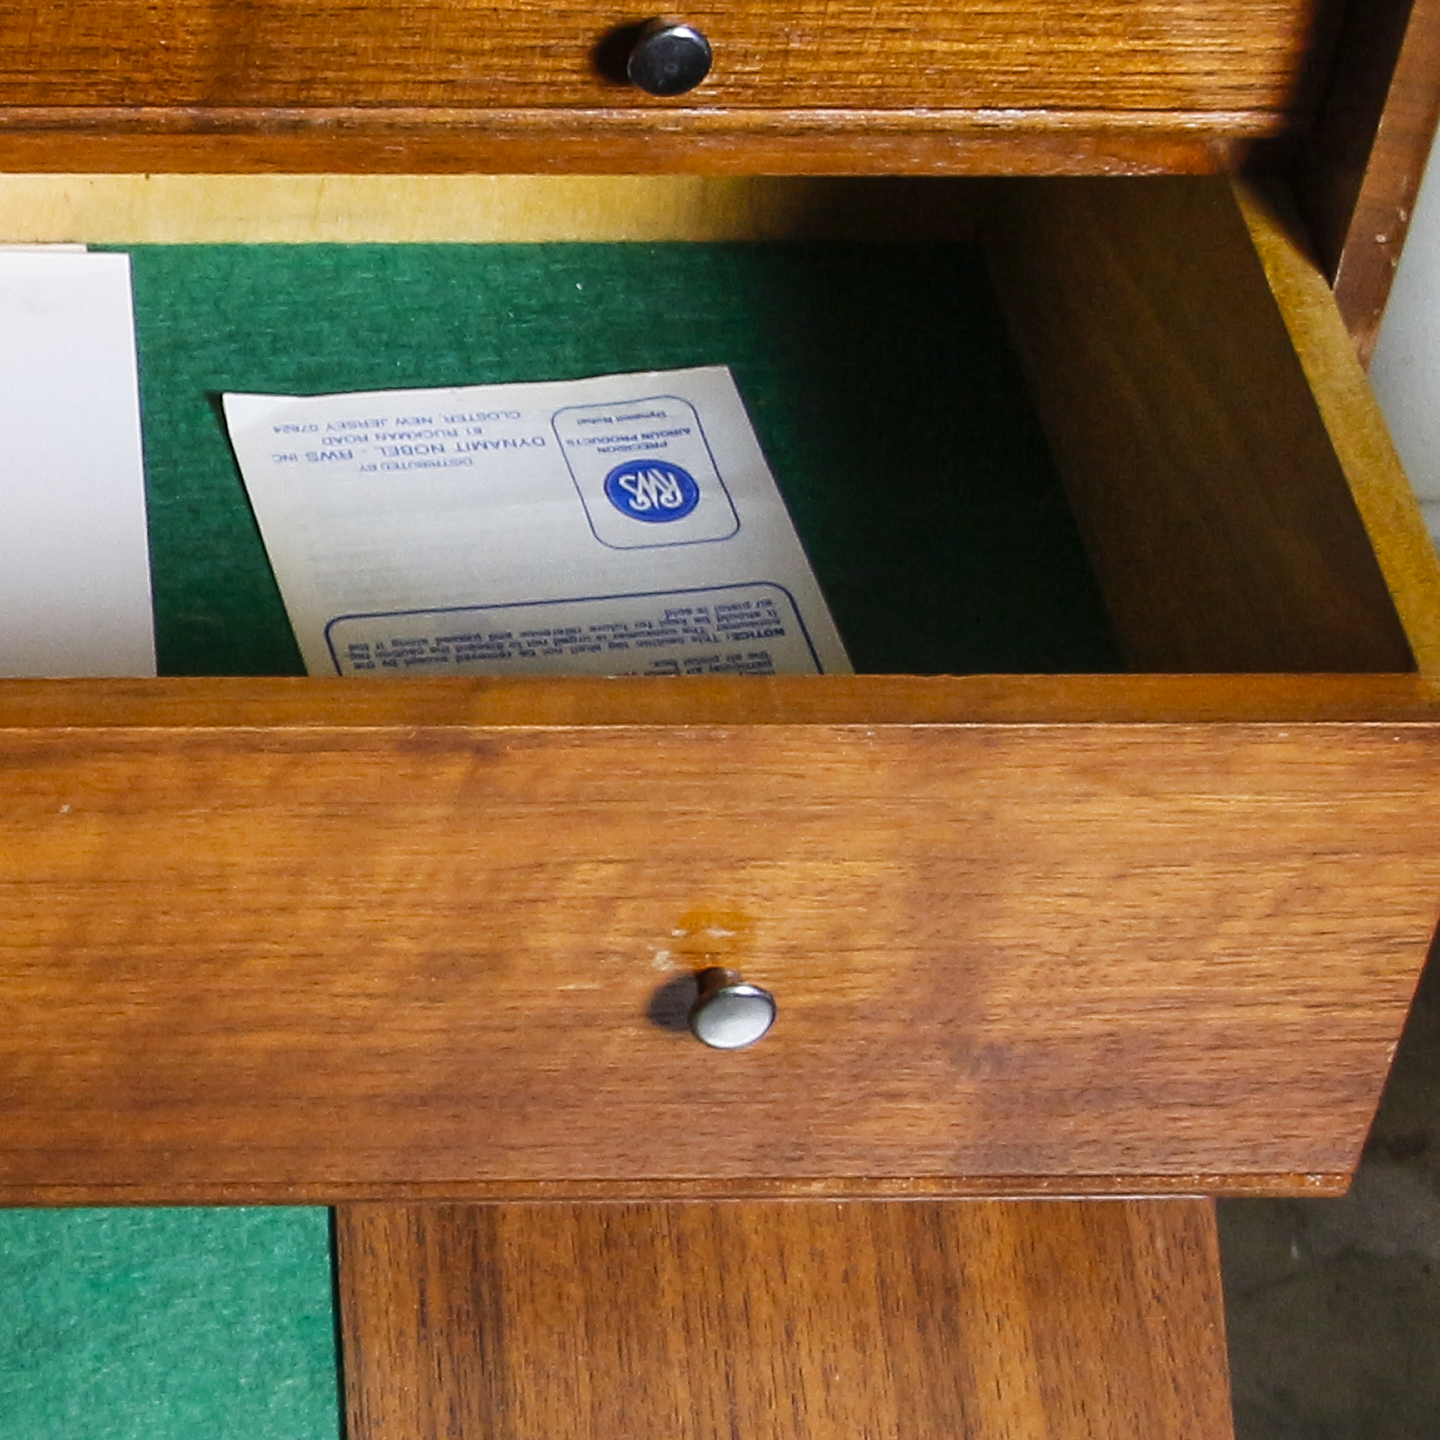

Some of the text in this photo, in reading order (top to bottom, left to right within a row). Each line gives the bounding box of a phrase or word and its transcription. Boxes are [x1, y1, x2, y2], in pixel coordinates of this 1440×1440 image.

[376, 444, 445, 456] NOBEL
[456, 436, 546, 452] DYNAMIT
[305, 450, 353, 462] RWS
[618, 468, 683, 511] RWS
